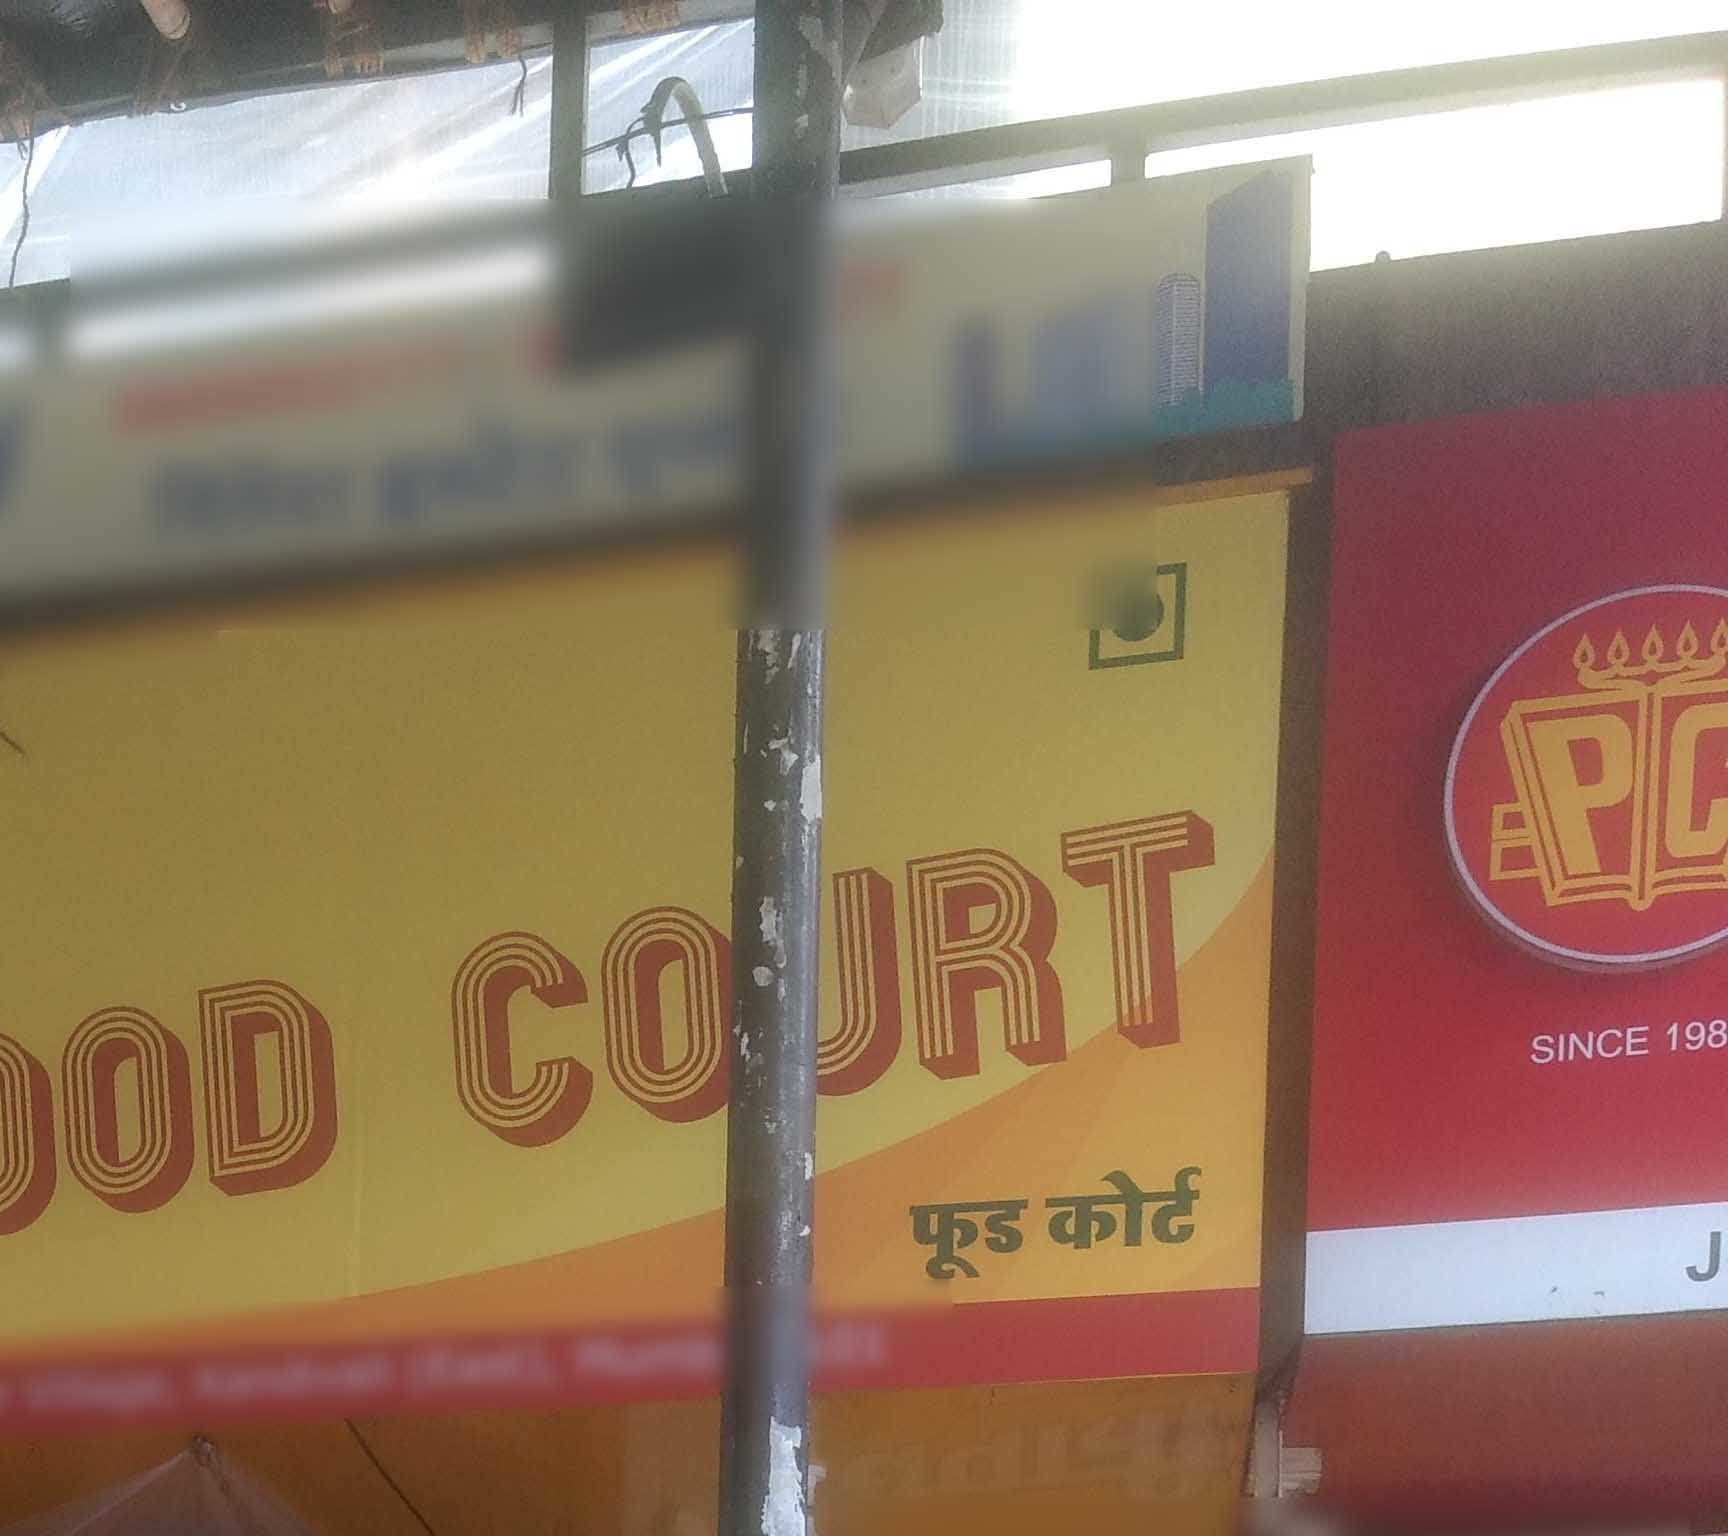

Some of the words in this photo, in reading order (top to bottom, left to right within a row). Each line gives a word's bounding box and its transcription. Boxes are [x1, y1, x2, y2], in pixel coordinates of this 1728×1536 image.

[450, 810, 1216, 1147] COURT
[1529, 1026, 1650, 1064] SINCE
[909, 1193, 1029, 1280] फूड
[1045, 1165, 1203, 1251] कोर्ट
